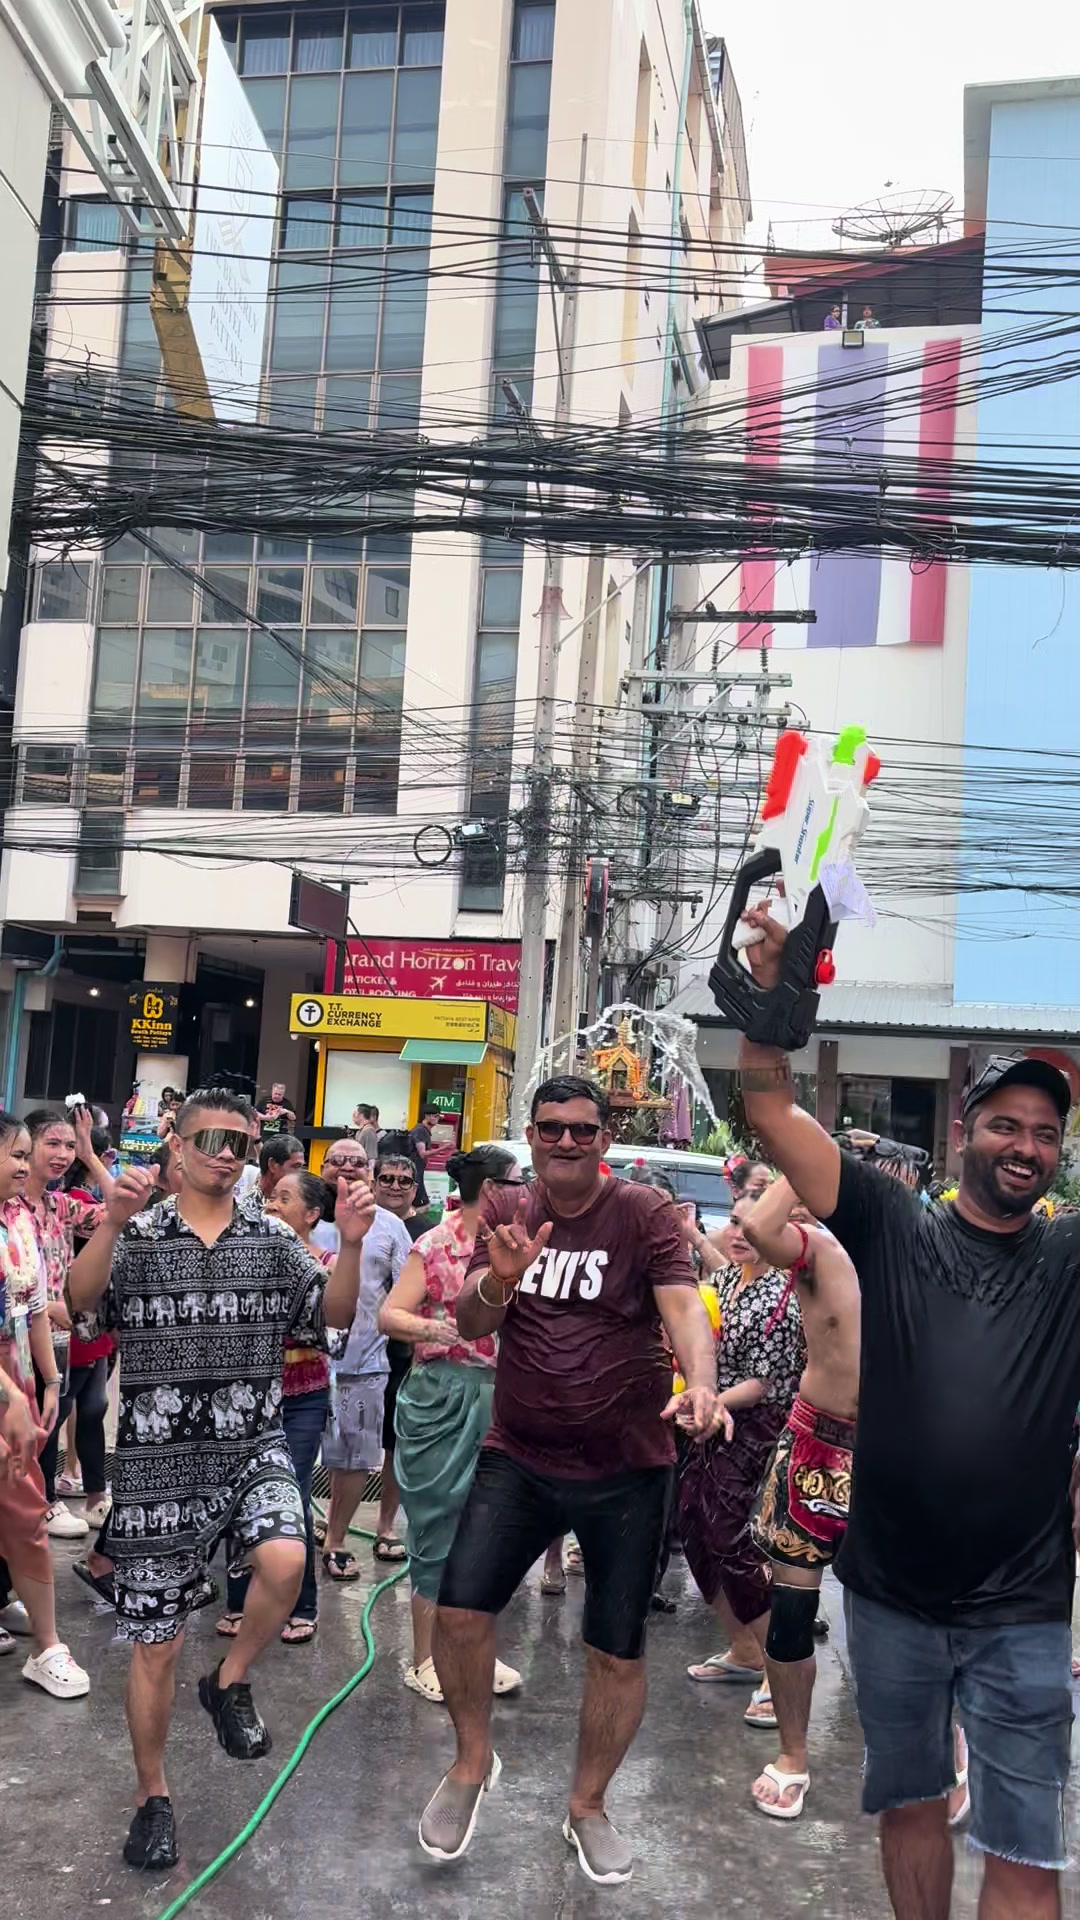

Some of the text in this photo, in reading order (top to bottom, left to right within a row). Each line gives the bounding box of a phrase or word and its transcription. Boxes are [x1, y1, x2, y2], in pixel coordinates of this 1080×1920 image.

[216, 280, 243, 343] HOTEL
[210, 305, 243, 378] PATTAYA
[400, 951, 476, 970] Horizon
[390, 977, 397, 985] &
[327, 1010, 382, 1020] CURRENCY
[132, 1018, 172, 1030] KKinn
[326, 1018, 382, 1027] EXCHANGE
[432, 1095, 455, 1107] ATM
[517, 1247, 609, 1300] EVI'S
